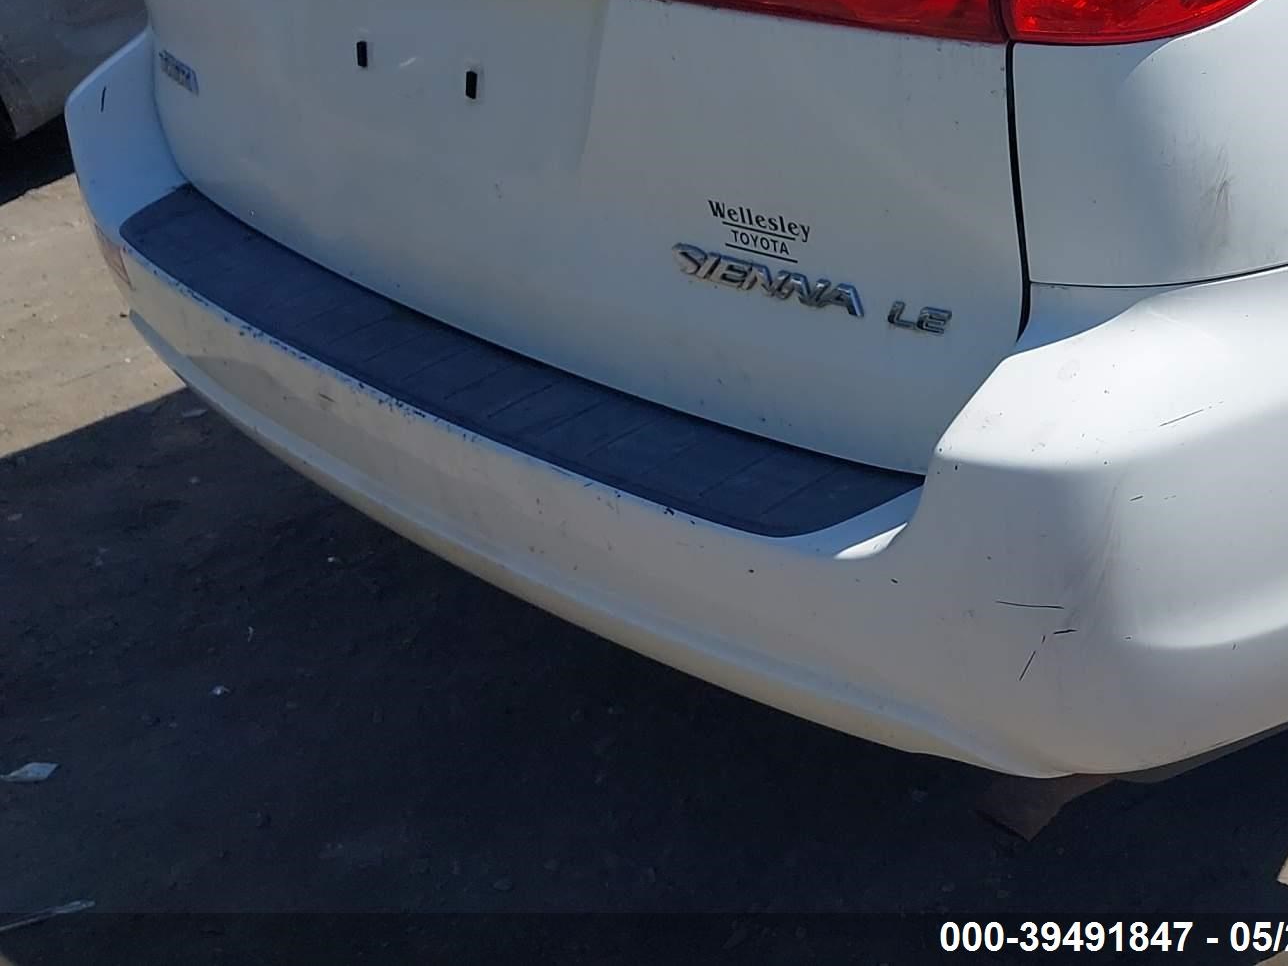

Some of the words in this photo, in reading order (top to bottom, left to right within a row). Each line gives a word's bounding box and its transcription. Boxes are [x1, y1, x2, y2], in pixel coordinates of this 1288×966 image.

[708, 200, 811, 242] Wellesley
[731, 229, 790, 256] TOYOTA
[670, 242, 865, 319] SIENNA
[887, 300, 953, 335] LE
